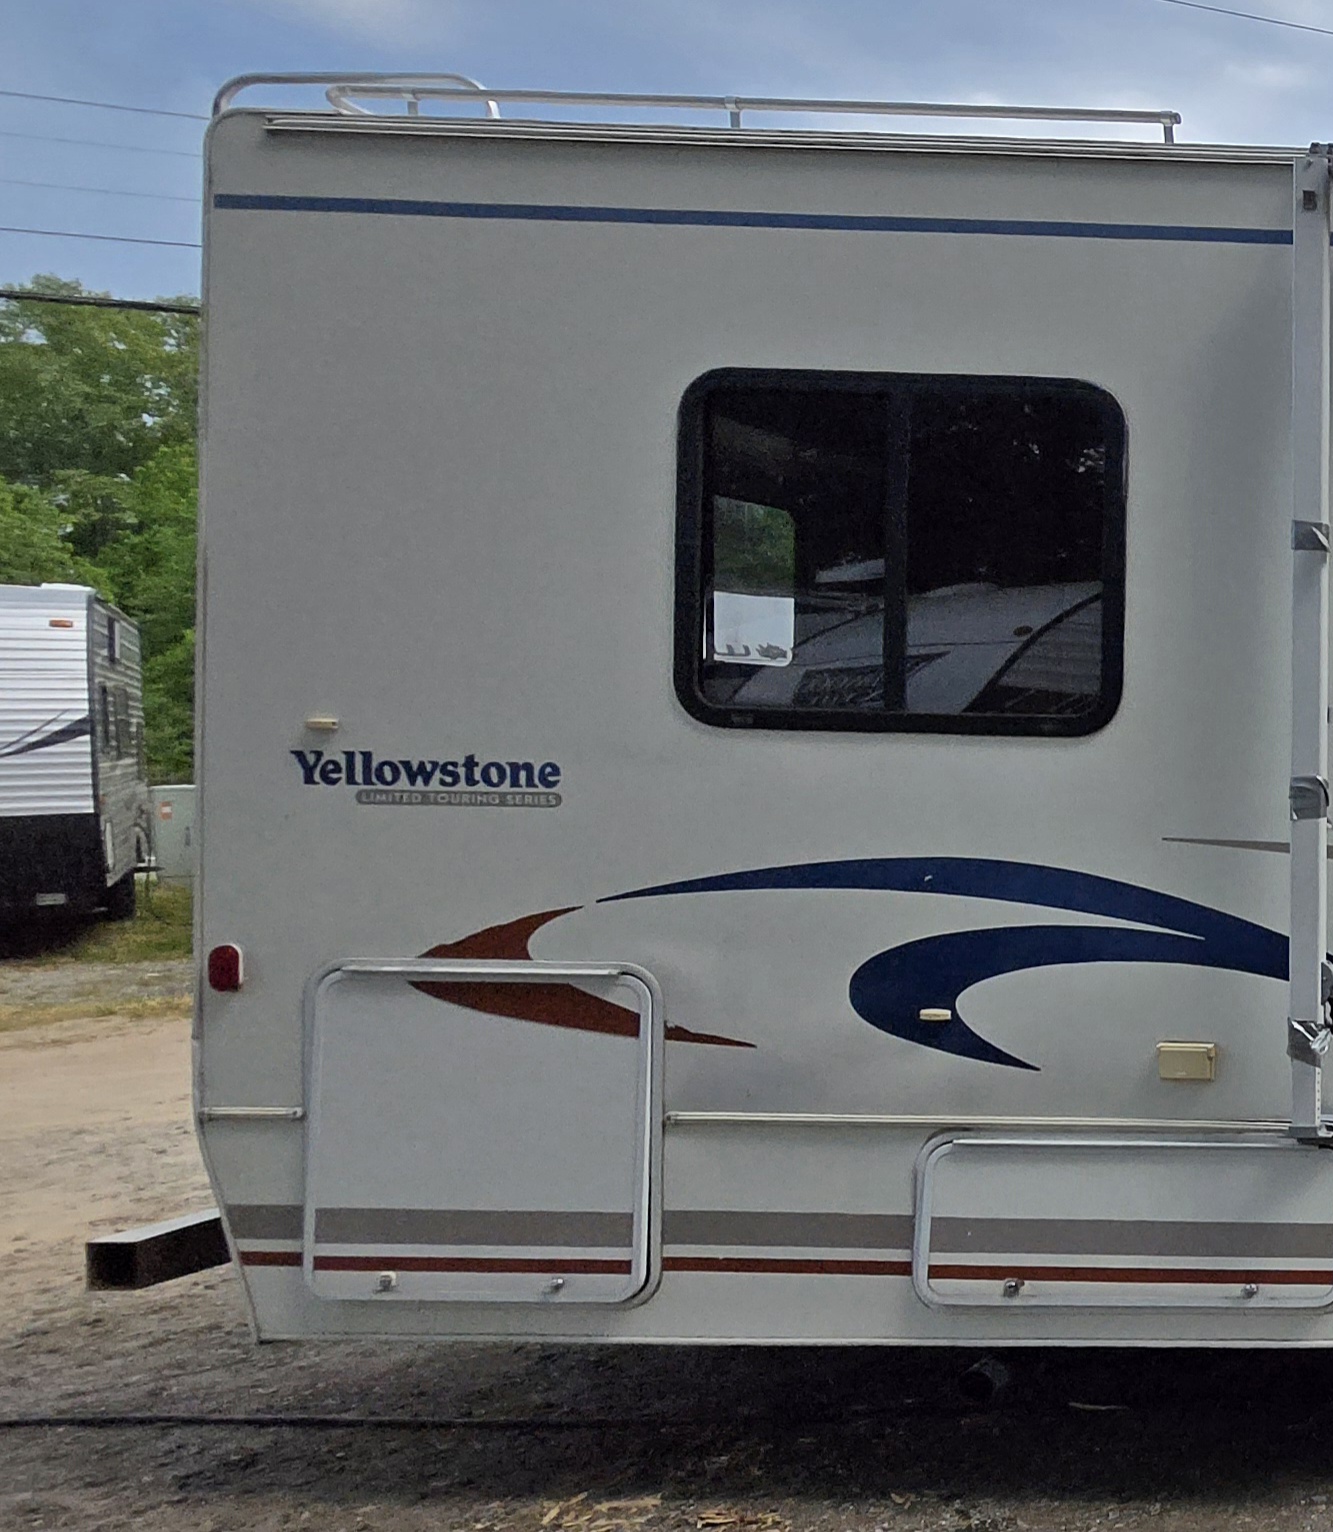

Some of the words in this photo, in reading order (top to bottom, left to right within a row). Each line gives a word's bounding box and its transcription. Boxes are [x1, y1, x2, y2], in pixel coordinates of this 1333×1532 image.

[290, 750, 562, 788] Yellowstone
[361, 792, 422, 803] LIMITED
[428, 792, 499, 804] TOURING
[506, 793, 556, 805] SERIES
